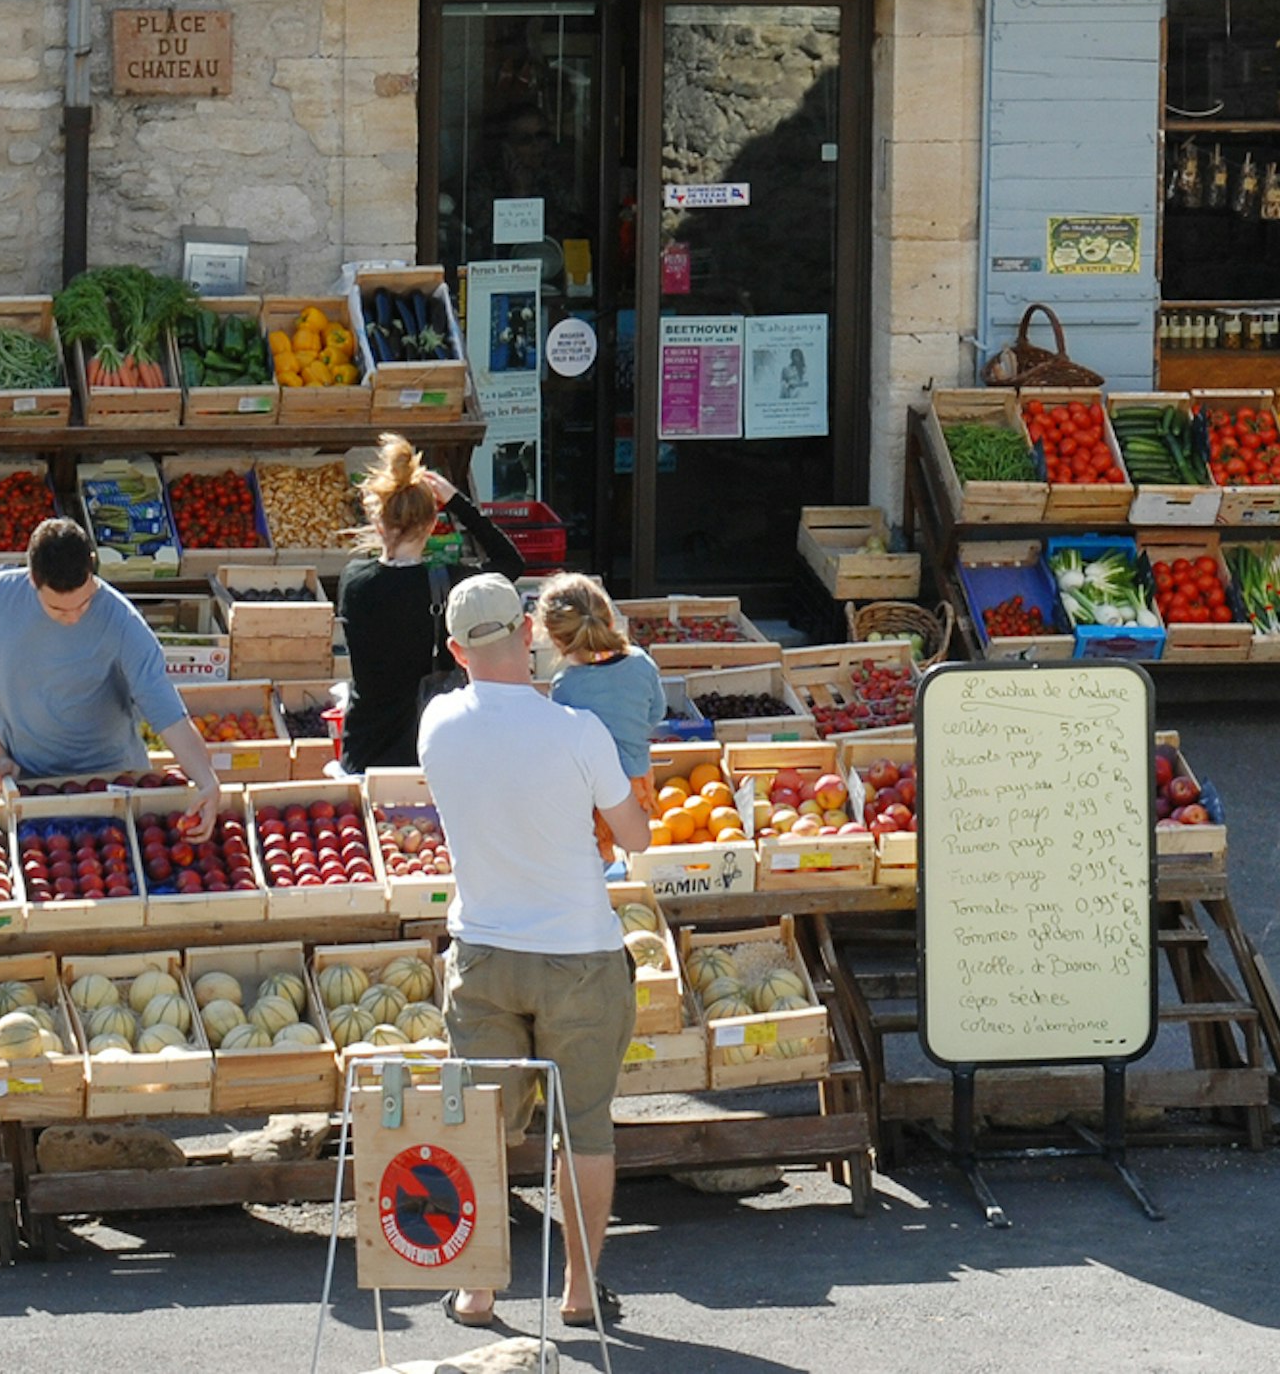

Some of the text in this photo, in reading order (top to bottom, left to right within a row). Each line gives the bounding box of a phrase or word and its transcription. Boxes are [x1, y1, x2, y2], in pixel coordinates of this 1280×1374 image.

[137, 12, 207, 34] PLACE
[158, 38, 188, 56] DU
[127, 59, 219, 79] CHATEAU
[665, 325, 738, 335] BEETHOVEN
[166, 663, 213, 674] LLETTO
